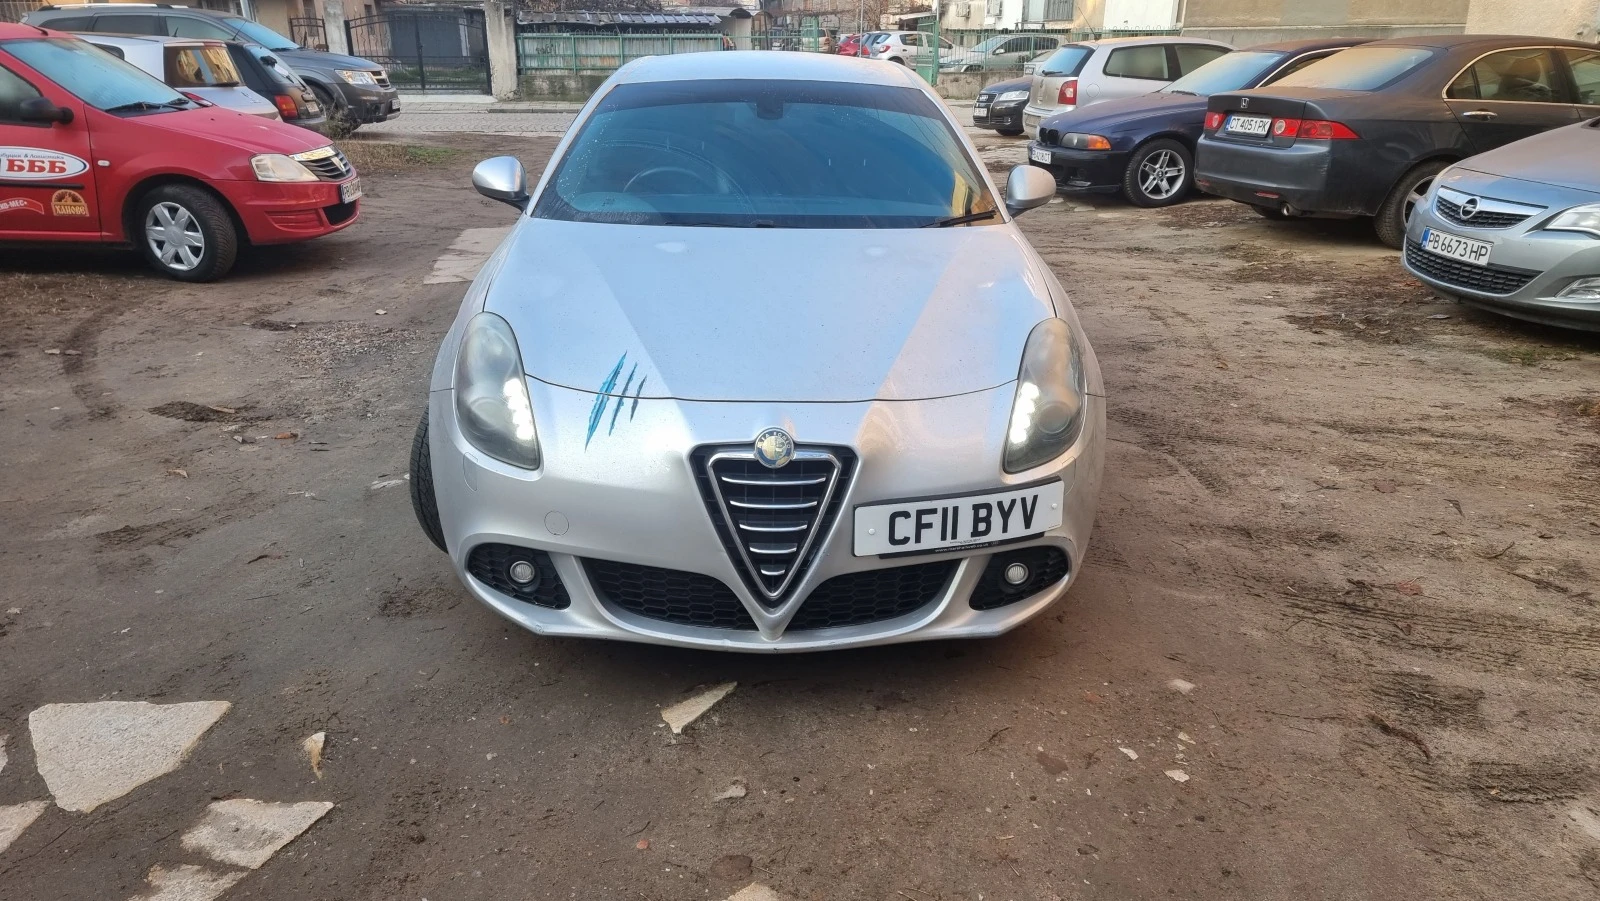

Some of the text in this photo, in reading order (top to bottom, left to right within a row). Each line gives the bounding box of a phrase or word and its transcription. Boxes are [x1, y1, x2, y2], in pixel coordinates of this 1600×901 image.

[1230, 118, 1269, 132] CT 4051 PK
[6, 159, 67, 173] БББ
[1428, 232, 1488, 261] PB 6673 HP
[888, 495, 1038, 546] CF11 BYV
